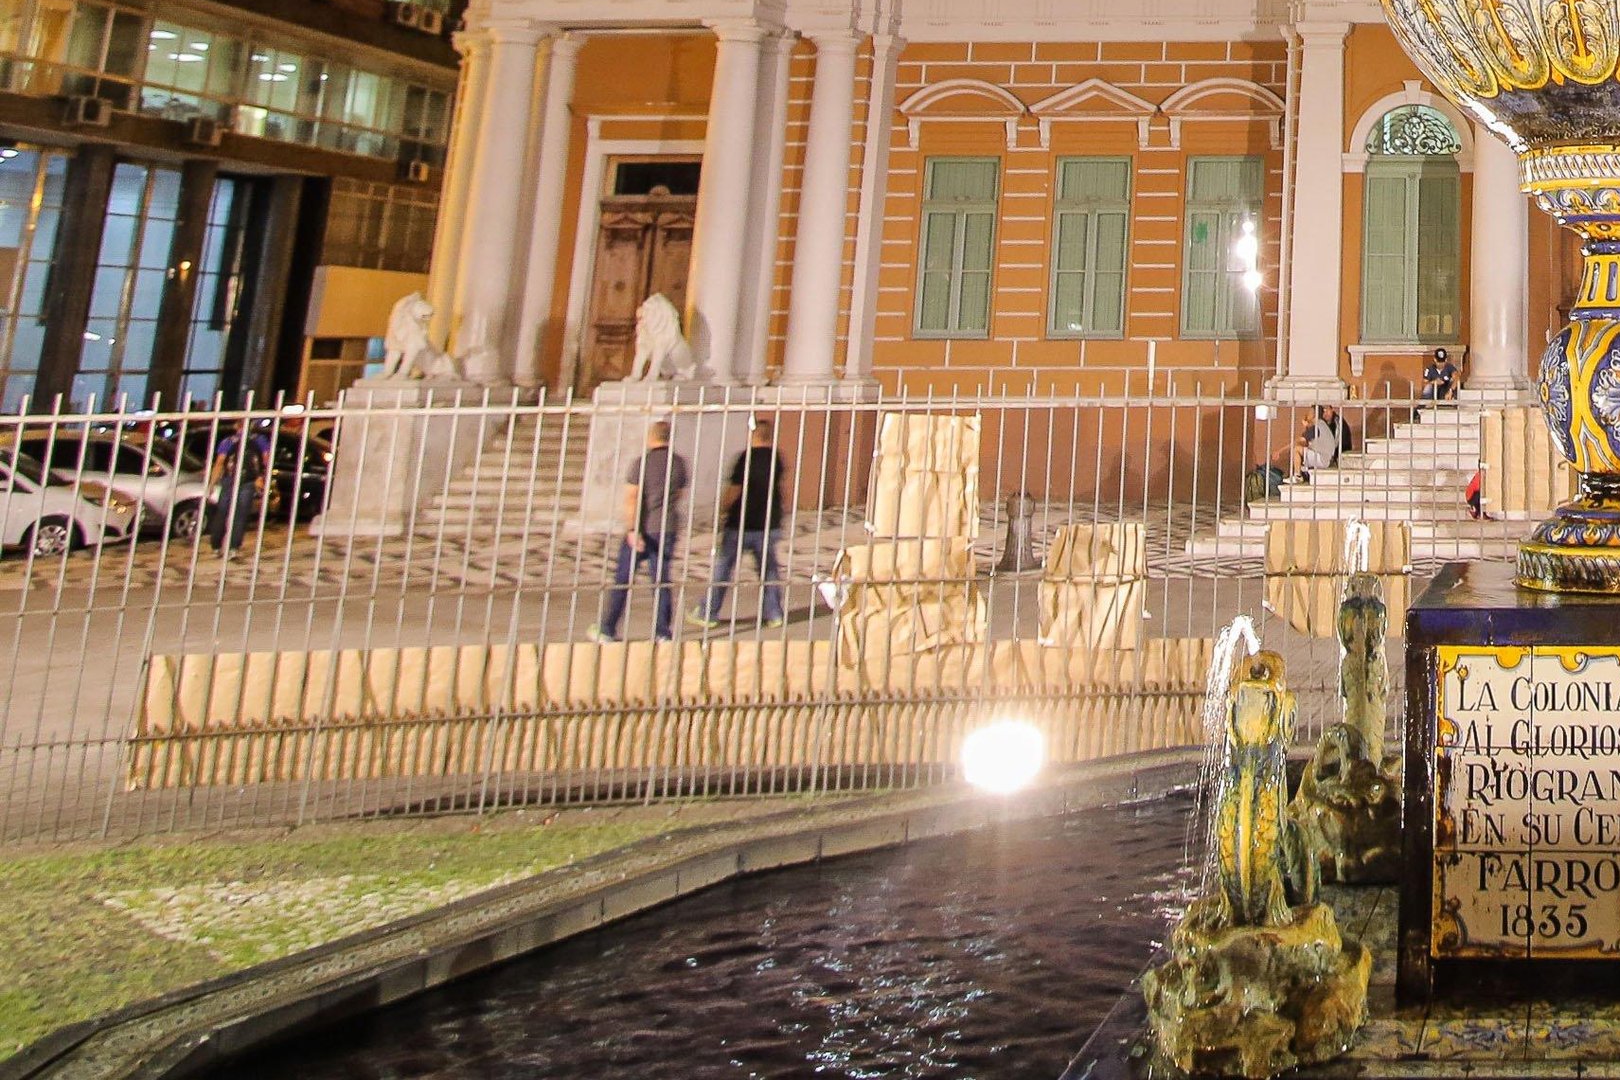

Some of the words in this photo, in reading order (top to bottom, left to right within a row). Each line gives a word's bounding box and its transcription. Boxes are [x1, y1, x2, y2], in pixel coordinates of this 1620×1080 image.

[1457, 676, 1499, 712] LA
[1462, 721, 1500, 757] AL
[1461, 809, 1504, 845] EN
[1520, 812, 1560, 845] SU
[1501, 904, 1588, 938] 1835
